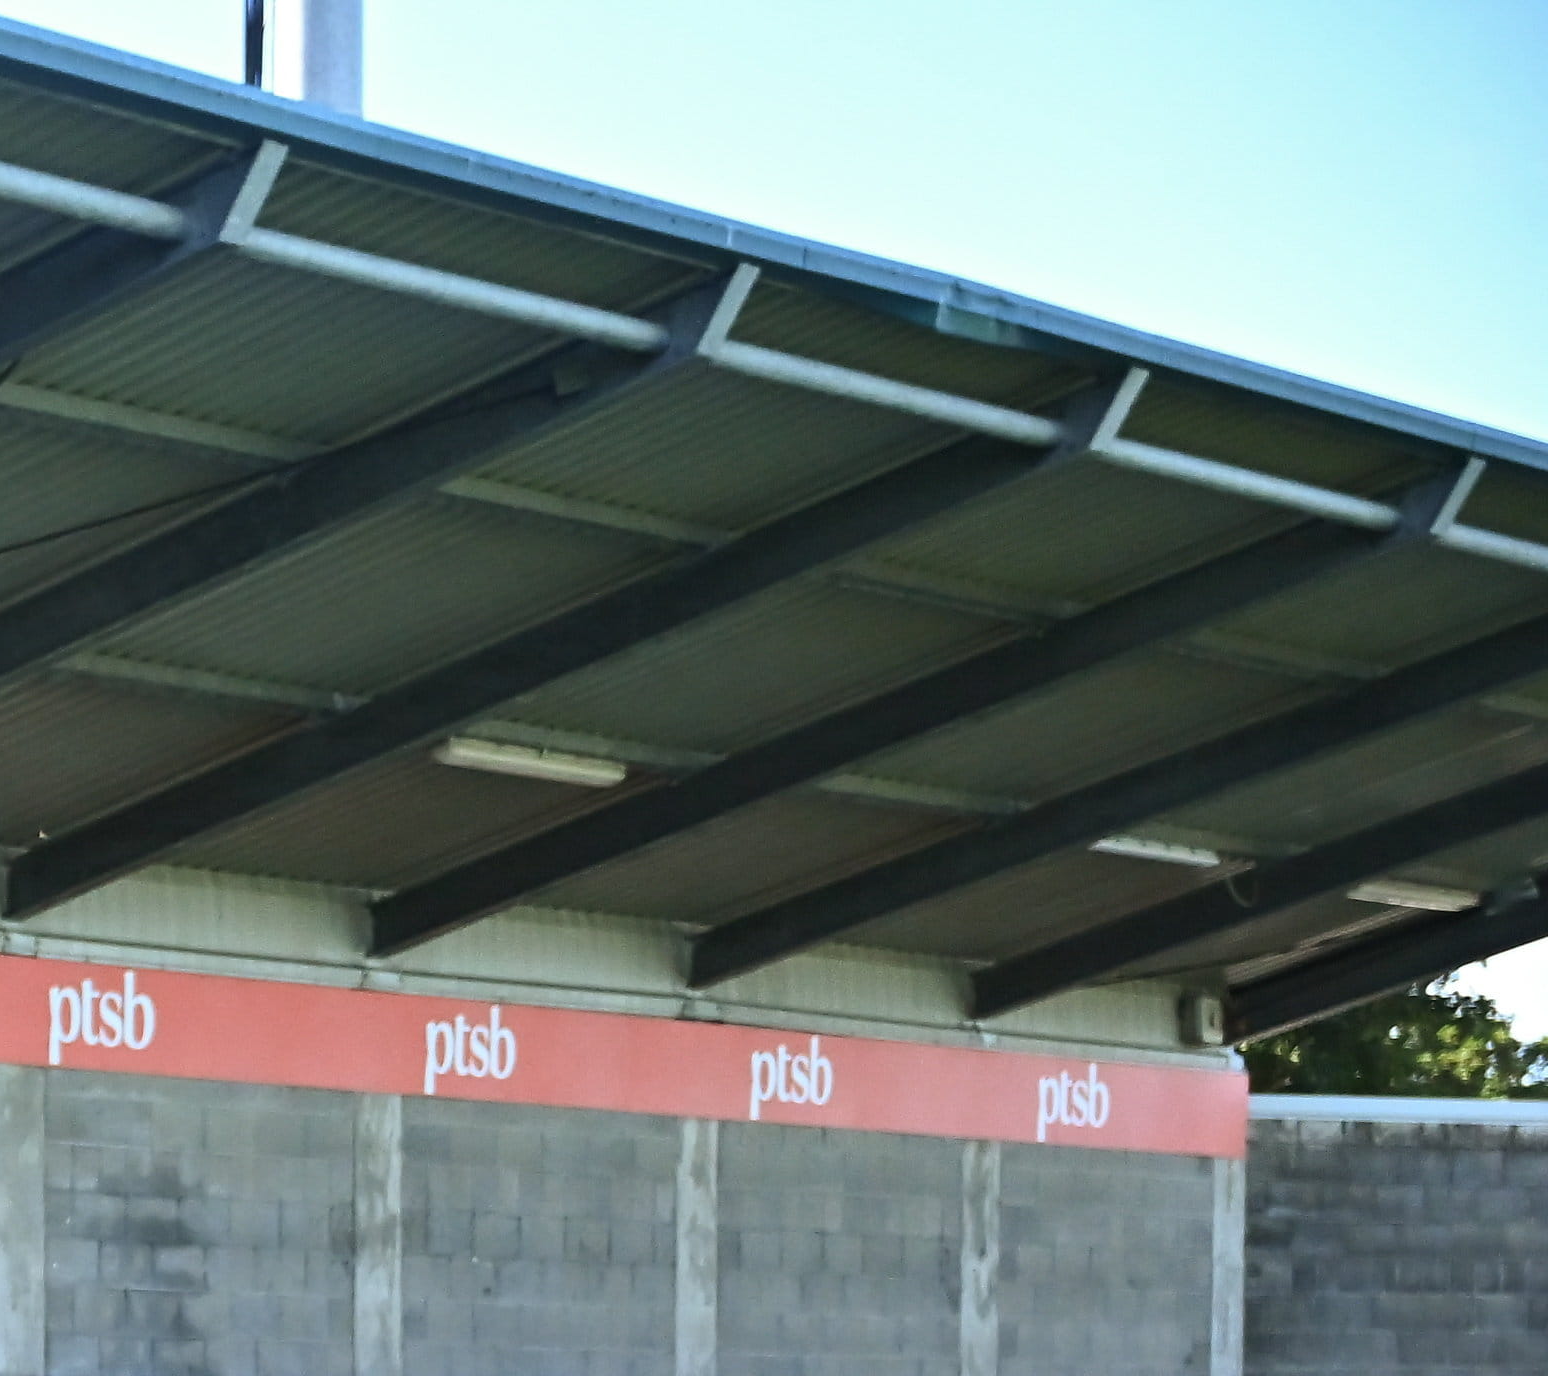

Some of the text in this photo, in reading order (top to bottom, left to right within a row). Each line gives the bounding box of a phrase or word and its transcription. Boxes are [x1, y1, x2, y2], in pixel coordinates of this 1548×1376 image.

[48, 970, 157, 1066] ptsb
[423, 1004, 518, 1096] ptsb
[749, 1035, 833, 1121] ptsb
[1036, 1062, 1110, 1143] ptsb
